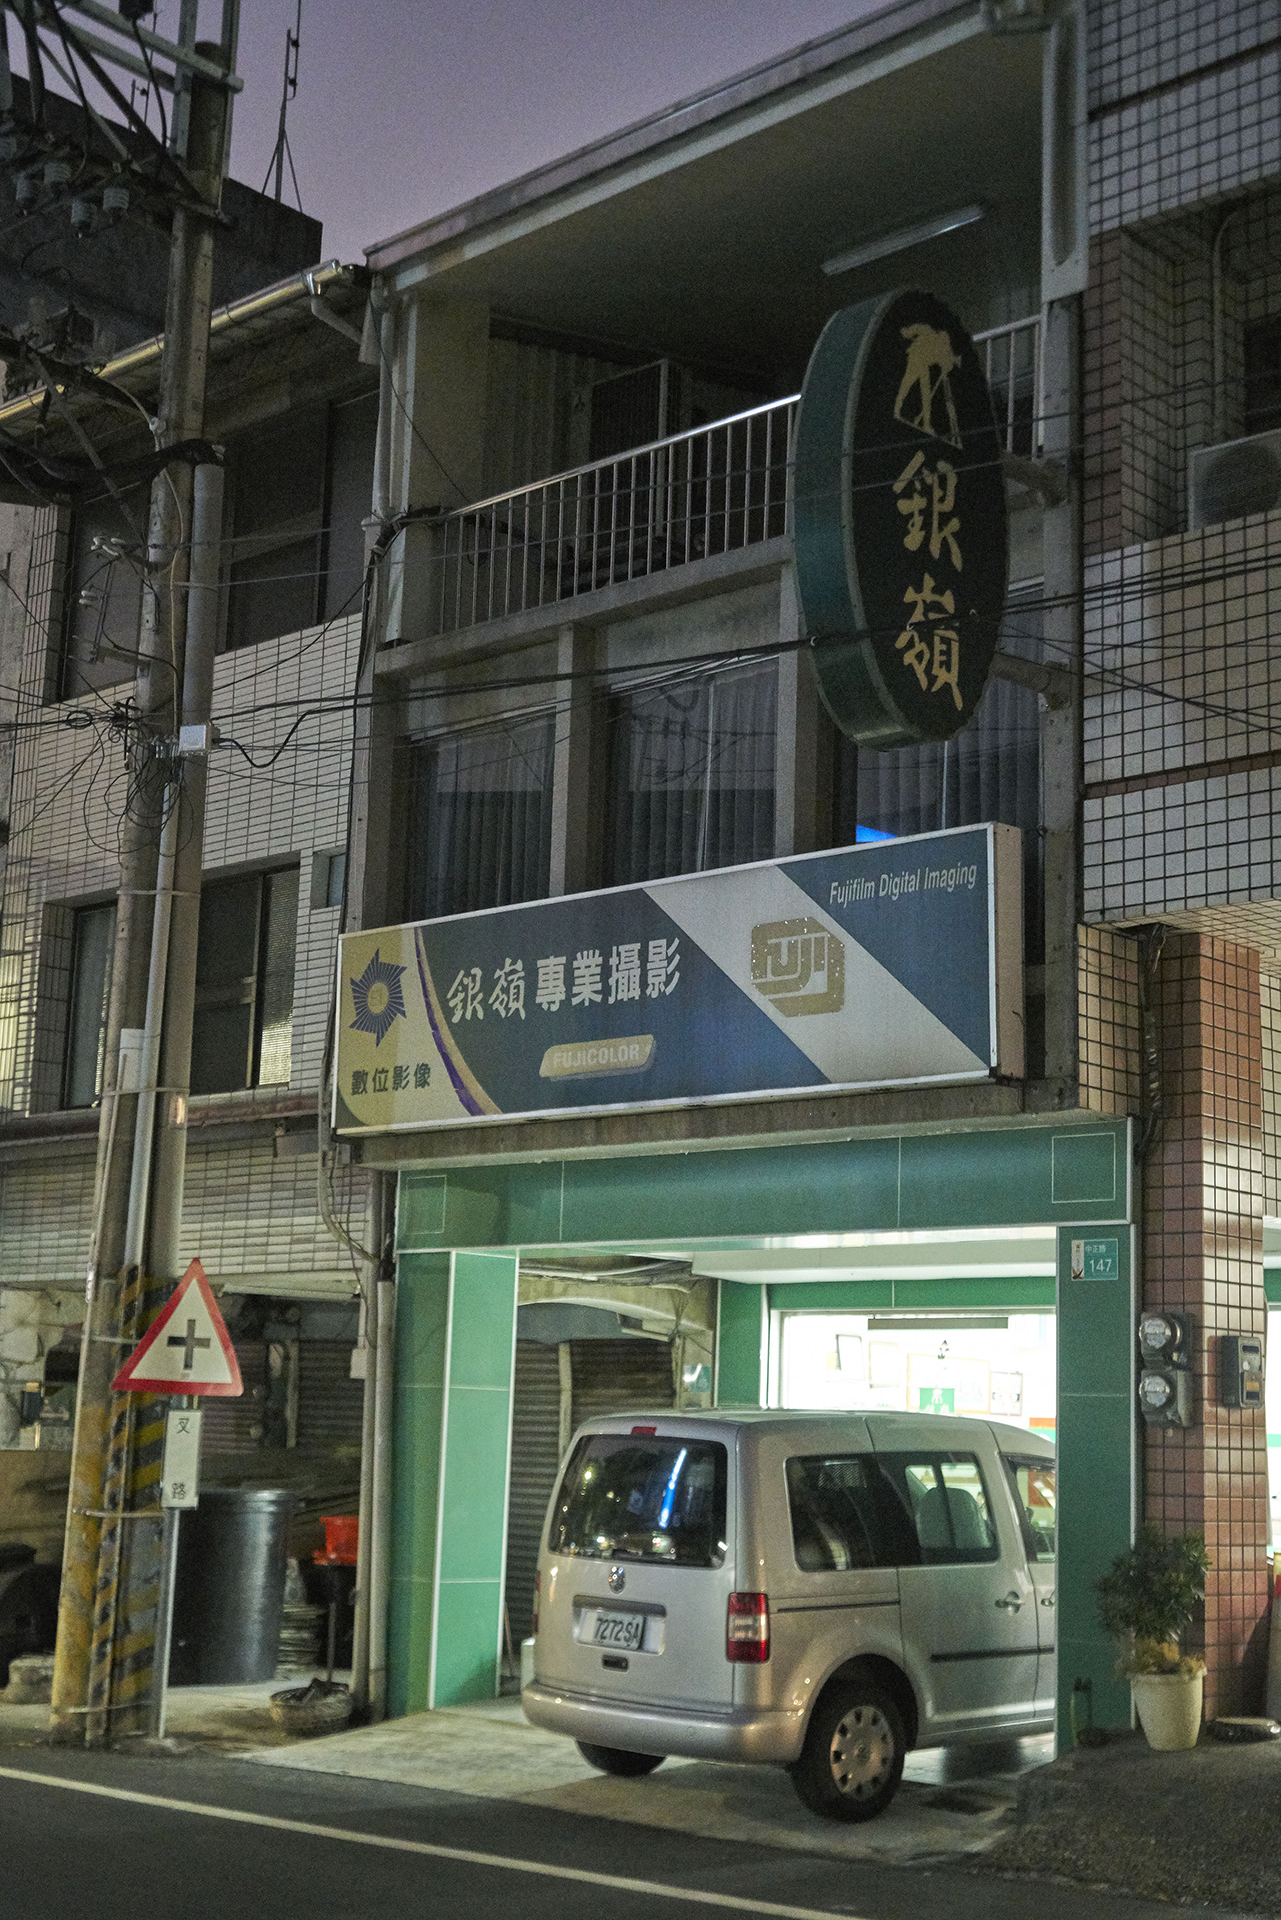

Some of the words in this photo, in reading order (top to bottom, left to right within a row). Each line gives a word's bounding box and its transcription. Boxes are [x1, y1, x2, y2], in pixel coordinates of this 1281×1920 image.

[892, 450, 964, 711] 銀嶺
[829, 881, 875, 908] Fujifilm
[879, 868, 920, 901] Digital
[923, 862, 978, 892] Imaging
[553, 1043, 640, 1068] FUJICOLOR
[350, 1062, 432, 1096] 數位影像
[1089, 1258, 1112, 1273] 147
